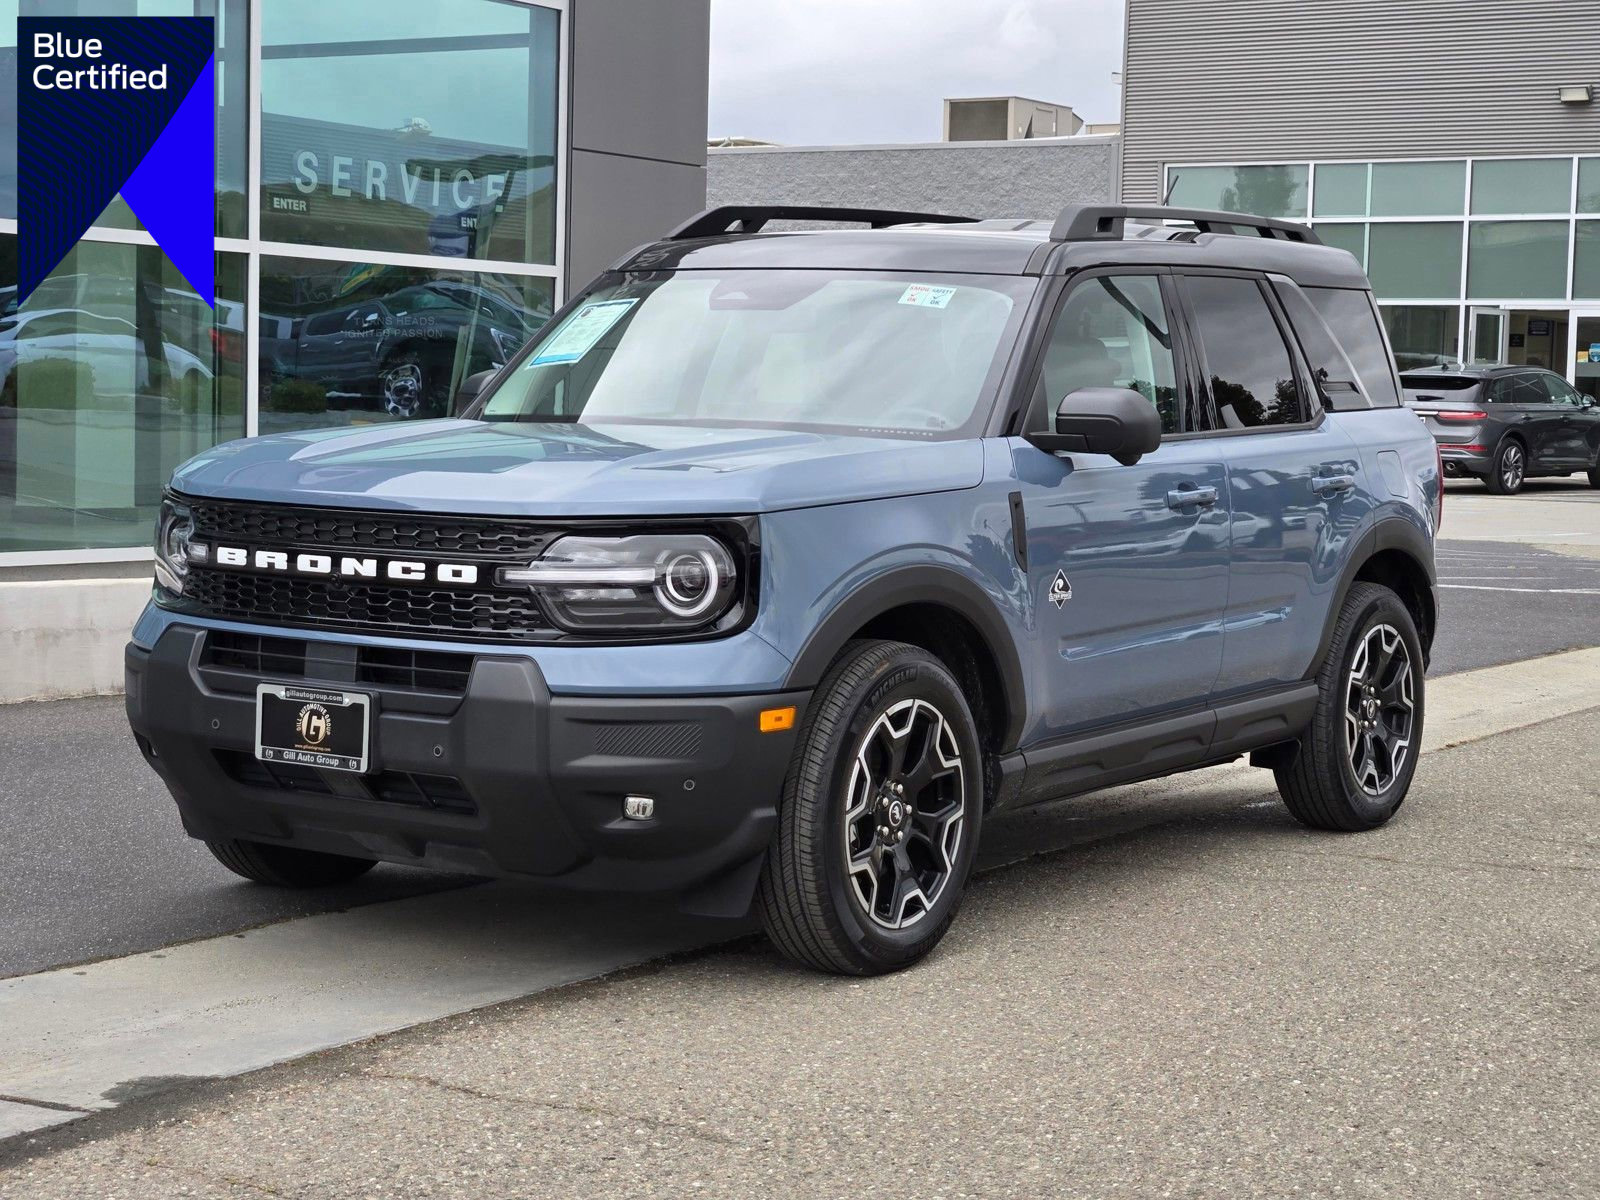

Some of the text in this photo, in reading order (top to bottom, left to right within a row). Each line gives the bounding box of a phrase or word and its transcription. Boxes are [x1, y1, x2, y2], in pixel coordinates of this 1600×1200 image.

[273, 197, 307, 212] ENTER
[461, 216, 478, 230] ENT
[216, 546, 478, 584] BRONCO
[871, 667, 917, 705] MICHELIN
[285, 689, 343, 703] gillautogroup.com
[283, 751, 340, 767] Gill Auto Group
